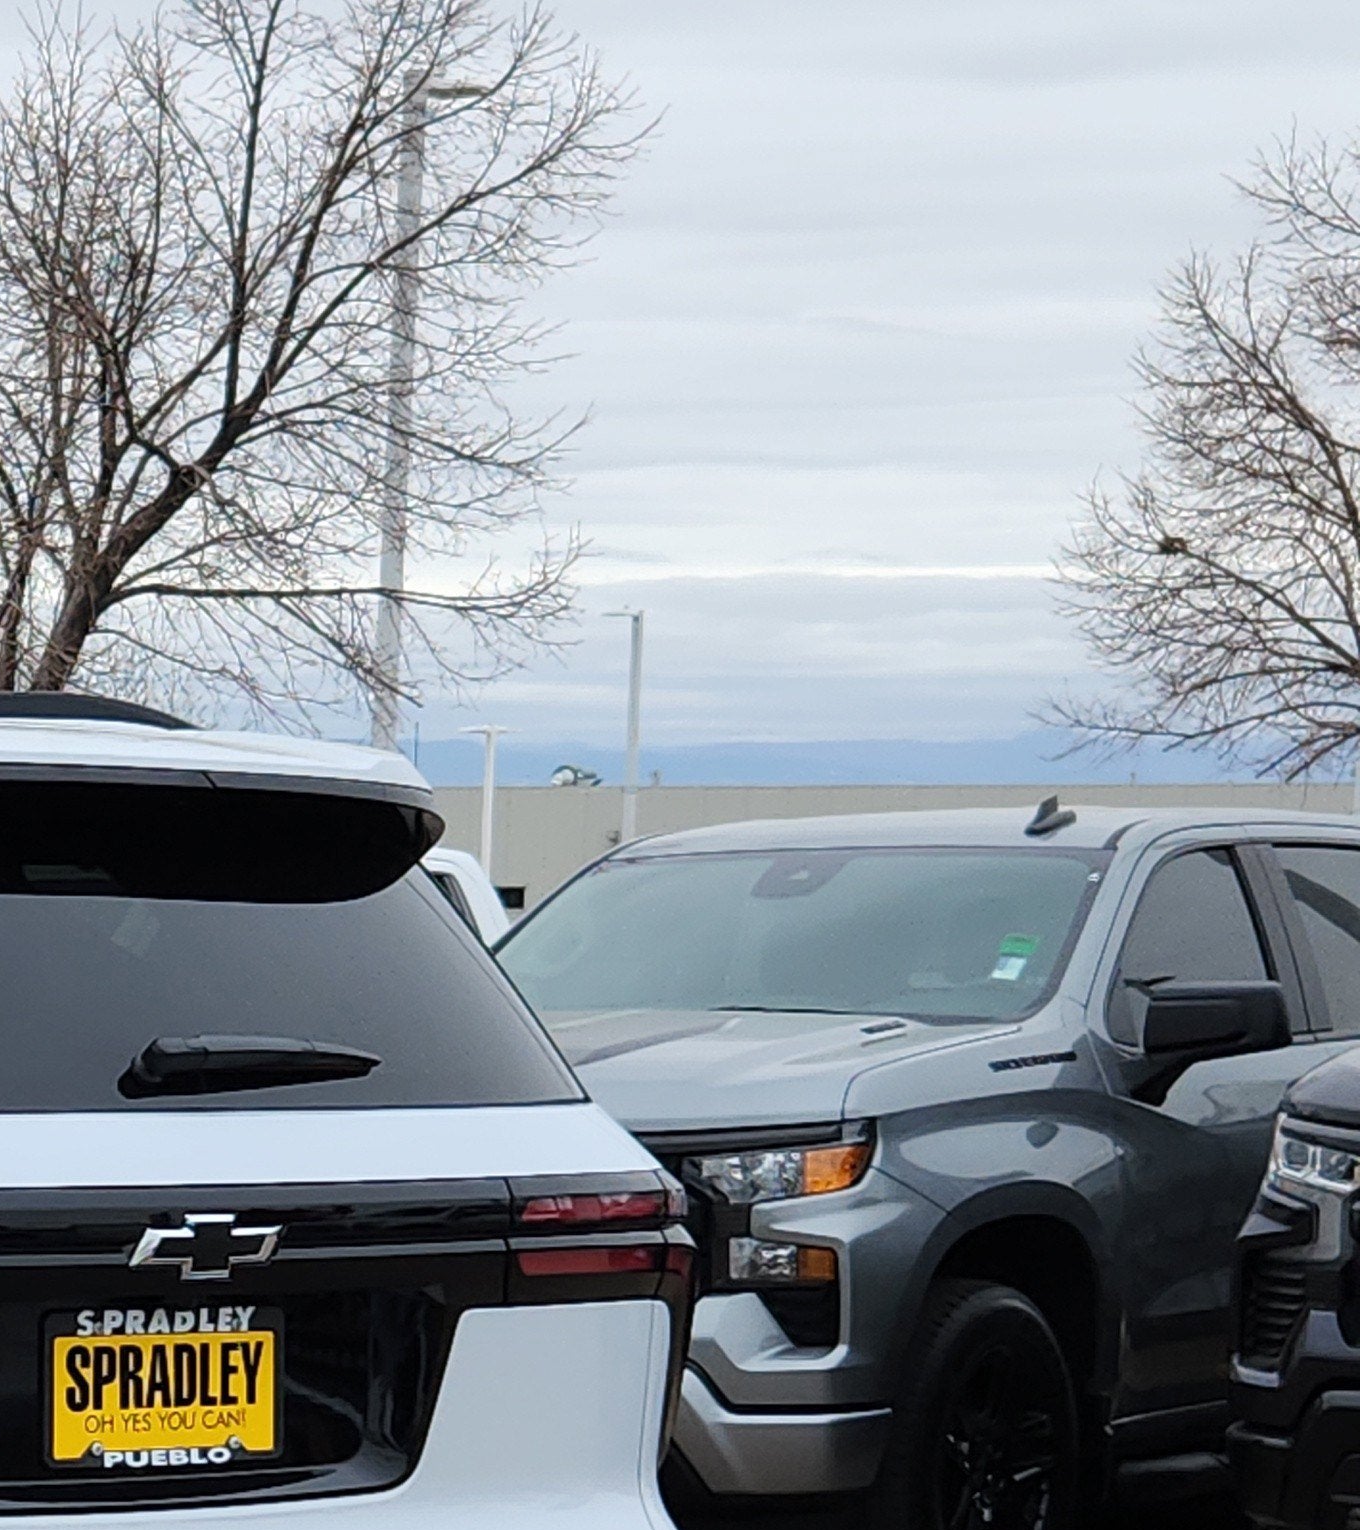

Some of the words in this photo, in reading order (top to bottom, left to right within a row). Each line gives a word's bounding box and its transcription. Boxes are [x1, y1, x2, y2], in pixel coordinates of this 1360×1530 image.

[65, 1340, 264, 1413] SPRADLEY
[84, 1414, 115, 1434] OH
[121, 1413, 152, 1433] YES
[156, 1410, 197, 1431] YOU
[201, 1408, 247, 1430] CAN!
[103, 1447, 231, 1468] PUEBLO
